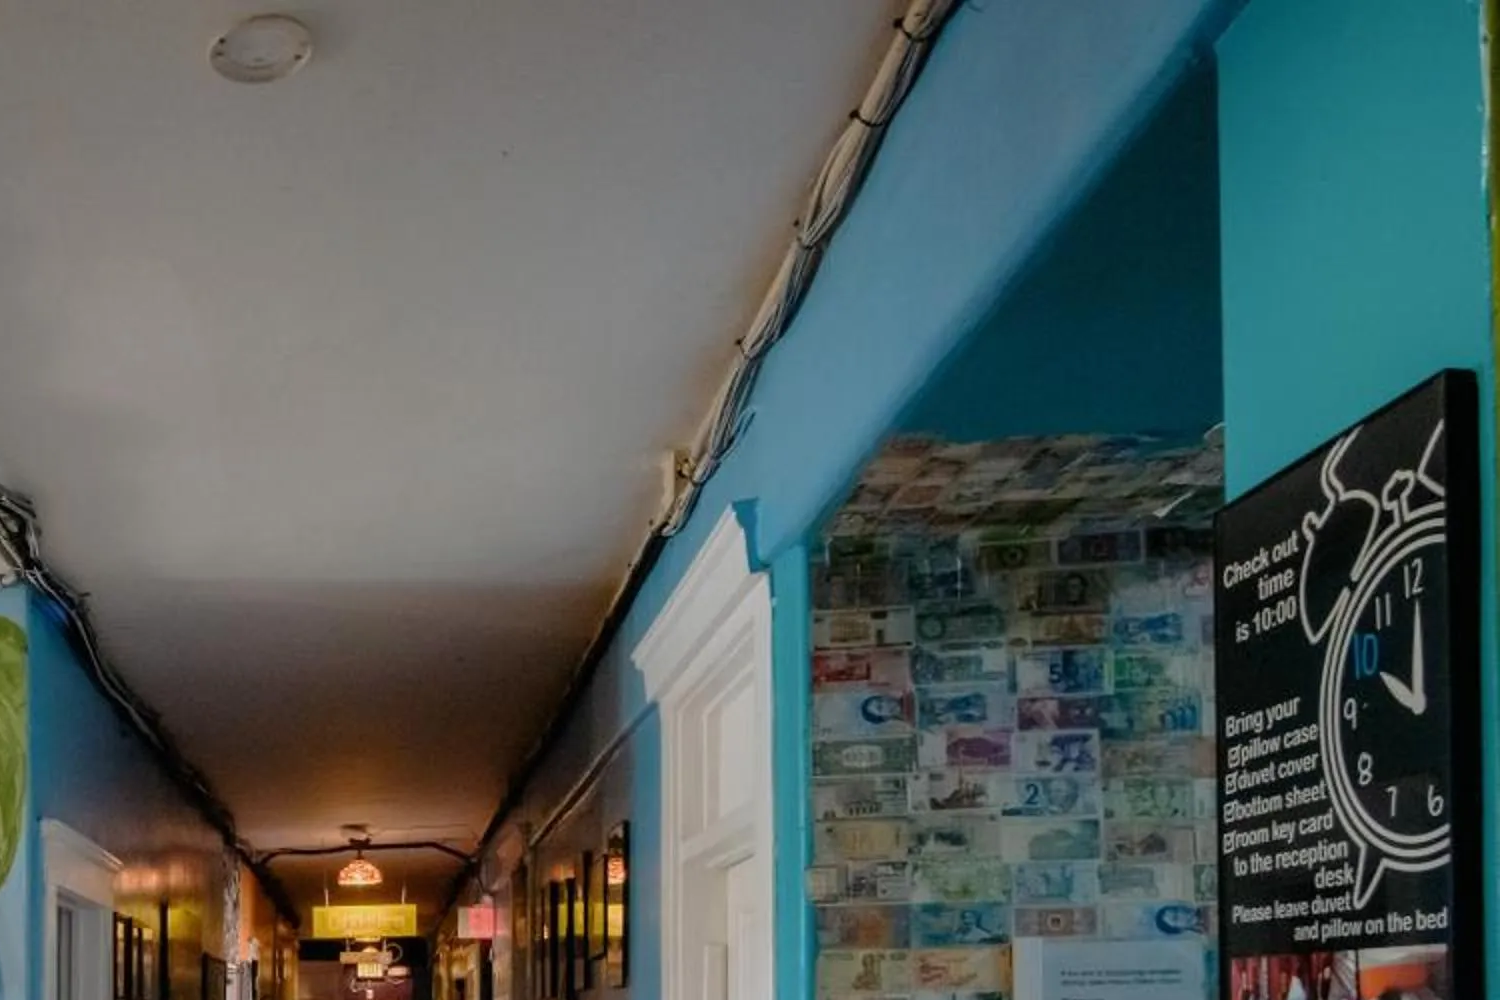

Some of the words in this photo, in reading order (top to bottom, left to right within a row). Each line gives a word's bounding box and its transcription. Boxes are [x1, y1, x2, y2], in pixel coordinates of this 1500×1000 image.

[1223, 547, 1269, 588] Check
[1272, 530, 1300, 568] out
[1404, 557, 1424, 599] 12
[1257, 568, 1295, 601] time
[1235, 619, 1250, 643] is
[1252, 595, 1298, 635] 10:00
[1375, 592, 1393, 631] 11
[1353, 632, 1379, 680] 10
[1224, 709, 1264, 738] Bring
[1265, 696, 1301, 728] your
[1343, 697, 1358, 731] 9
[1241, 736, 1282, 766] pillow
[1283, 722, 1319, 748] case
[1237, 761, 1276, 789] duvet
[1277, 752, 1319, 780] cover
[1357, 752, 1374, 786] 8
[1235, 792, 1283, 819] bottom
[1285, 779, 1329, 808] sheet
[1385, 785, 1399, 817] 7
[1427, 784, 1444, 817] 6
[1234, 827, 1270, 848] room
[1271, 819, 1295, 844] key
[1298, 808, 1334, 835] card
[1233, 856, 1248, 877] to
[1250, 852, 1273, 873] the
[1275, 839, 1349, 869] reception
[1314, 864, 1355, 889] desk
[1232, 904, 1273, 924] Please
[1274, 899, 1310, 919] leave
[1311, 892, 1352, 916] duvet
[1293, 921, 1319, 941] and
[1321, 918, 1363, 943] pillow
[1365, 918, 1385, 934] on
[1387, 911, 1413, 931] the
[1416, 906, 1449, 929] bed
